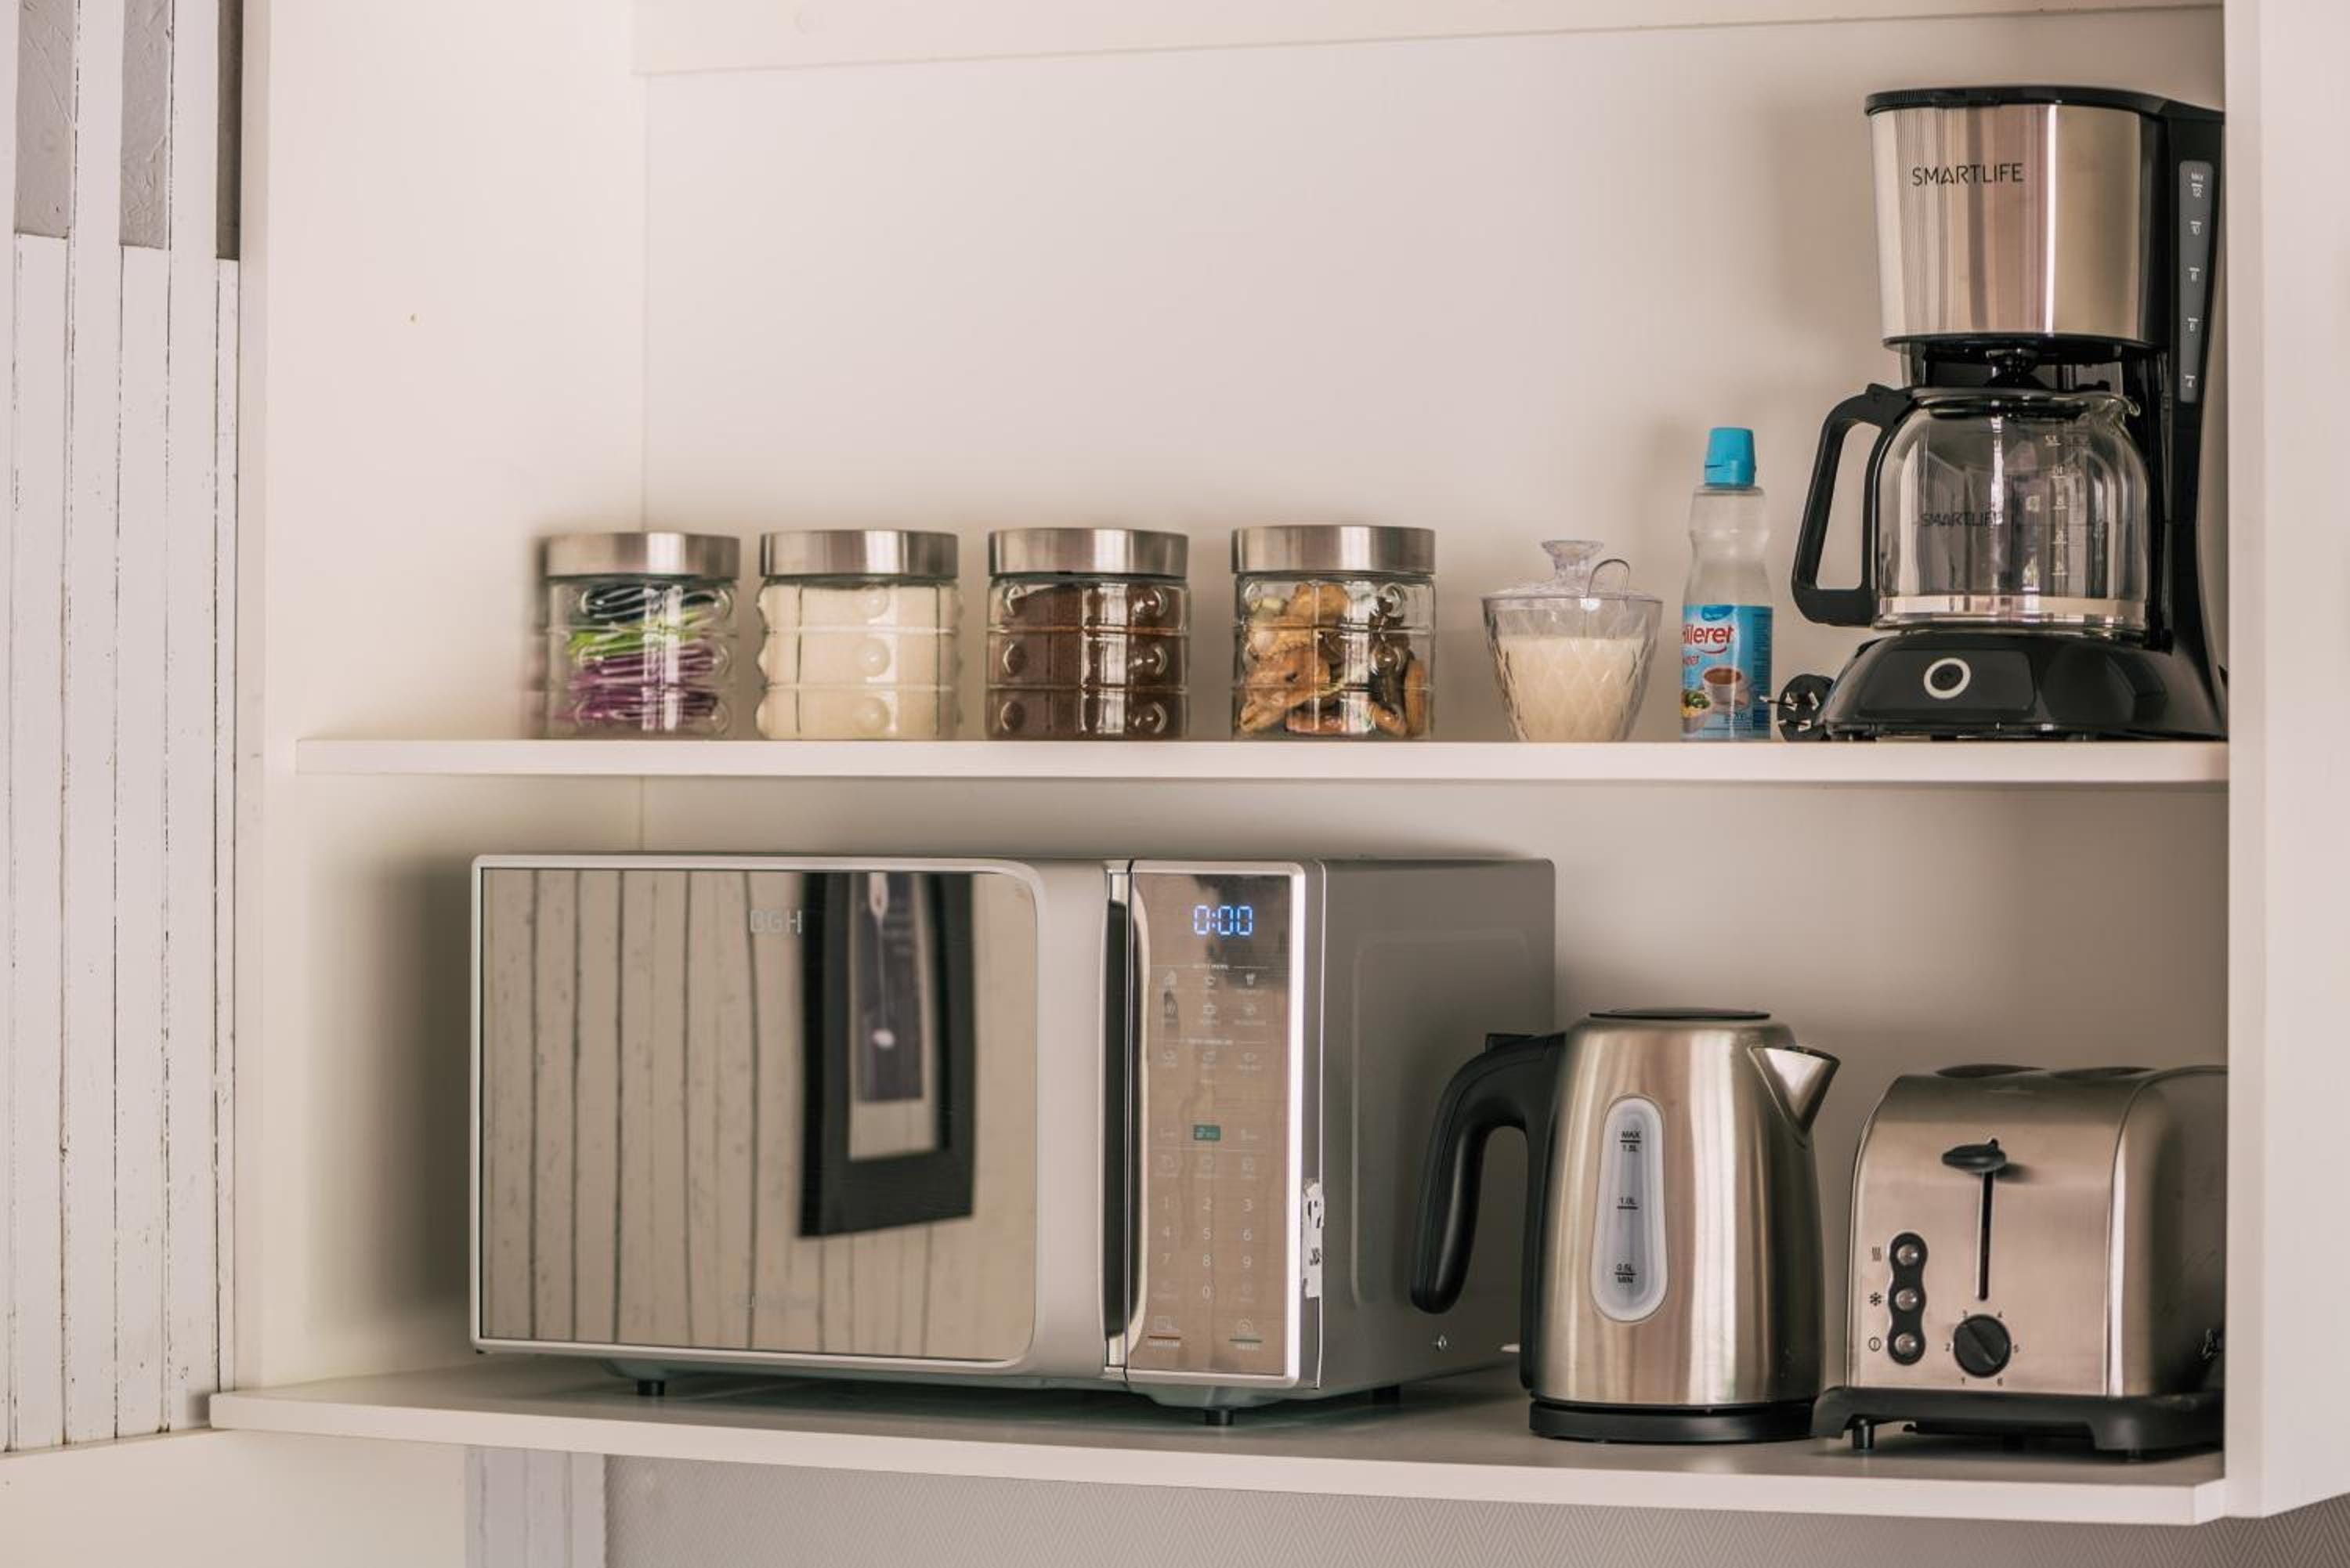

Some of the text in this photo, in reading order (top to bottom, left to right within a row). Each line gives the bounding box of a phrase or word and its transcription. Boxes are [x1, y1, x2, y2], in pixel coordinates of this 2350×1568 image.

[1912, 163, 2024, 186] SMARTLIFE
[1194, 905, 1253, 936] 0:00
[1622, 1130, 1642, 1140] MAX
[1202, 1197, 1212, 1211] 2
[1243, 1198, 1253, 1212] 3
[1202, 1227, 1211, 1241] 5
[1242, 1227, 1252, 1241] 6
[1202, 1253, 1212, 1266] 8
[1242, 1255, 1252, 1269] 9
[1202, 1284, 1211, 1299] 0
